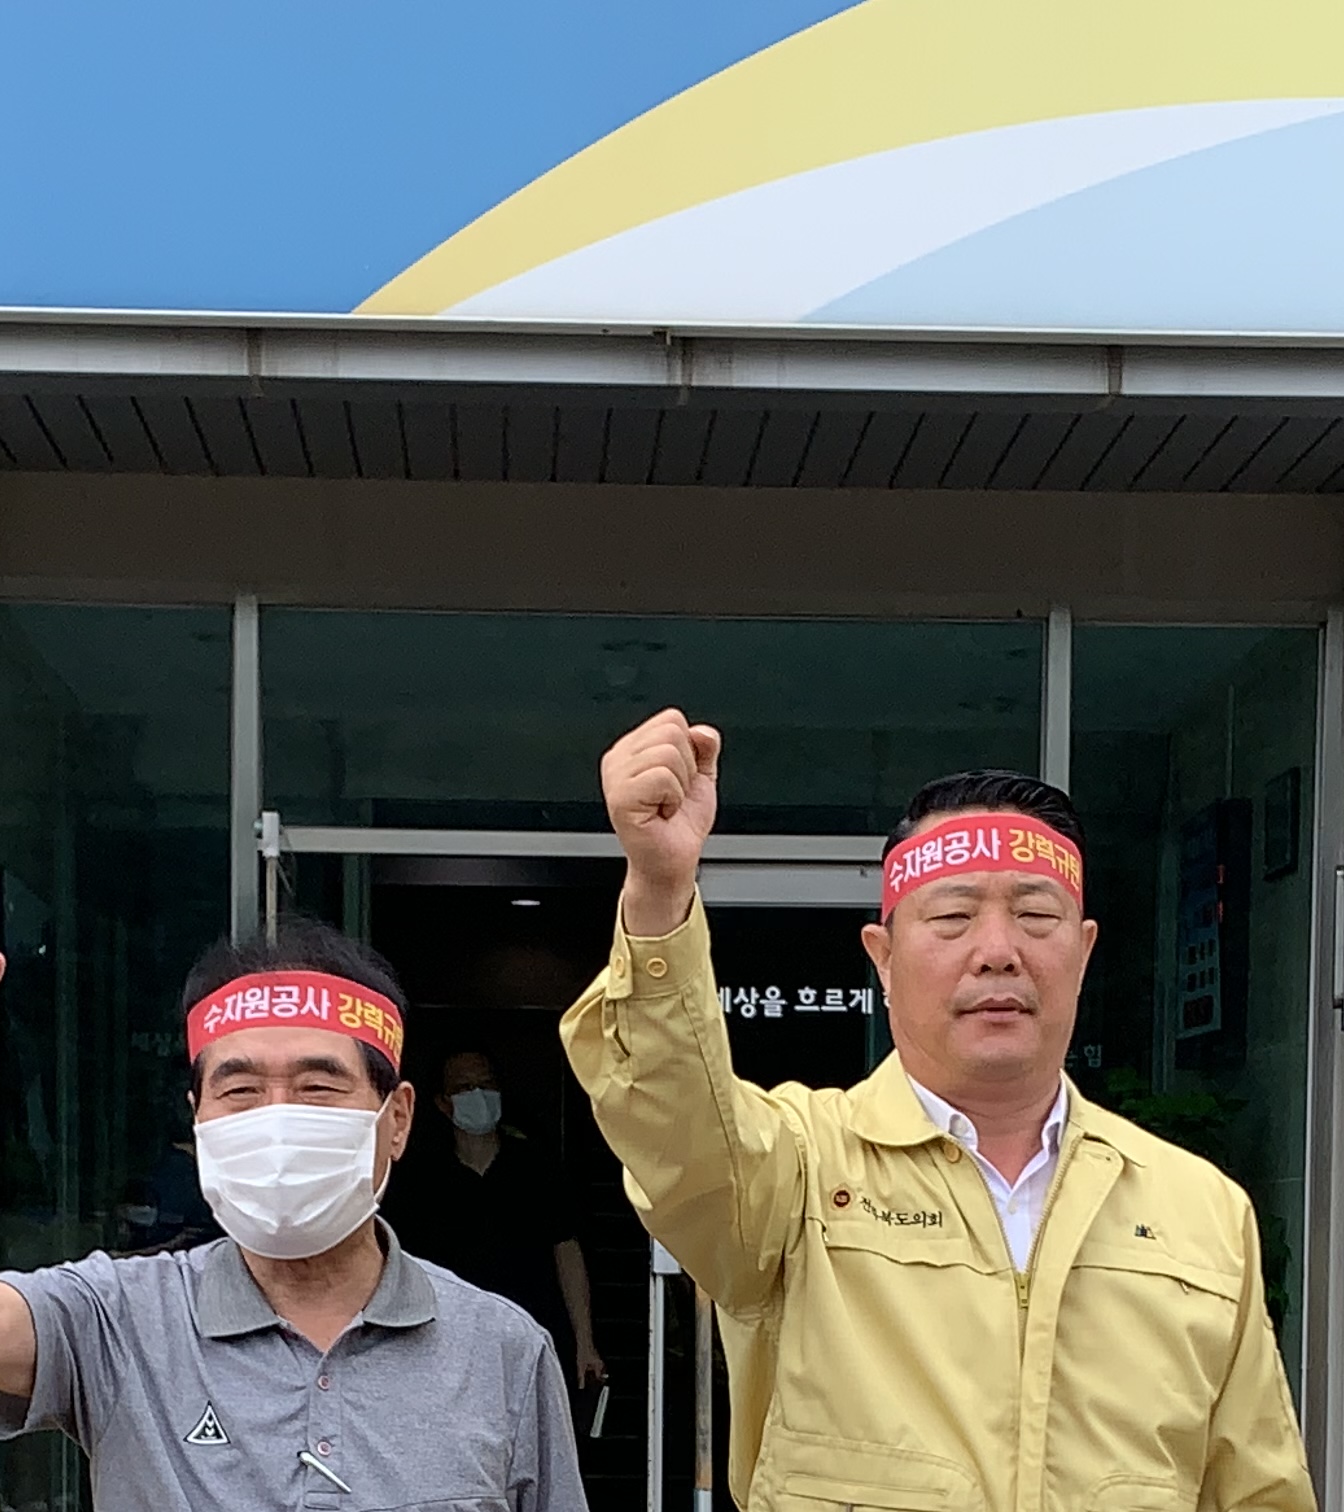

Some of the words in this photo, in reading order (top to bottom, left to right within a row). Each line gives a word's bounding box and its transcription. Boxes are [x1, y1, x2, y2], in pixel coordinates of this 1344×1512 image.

[889, 828, 1001, 893] 수자원공사
[204, 985, 331, 1033] 수자원공사
[793, 985, 875, 1016] 흐르게
